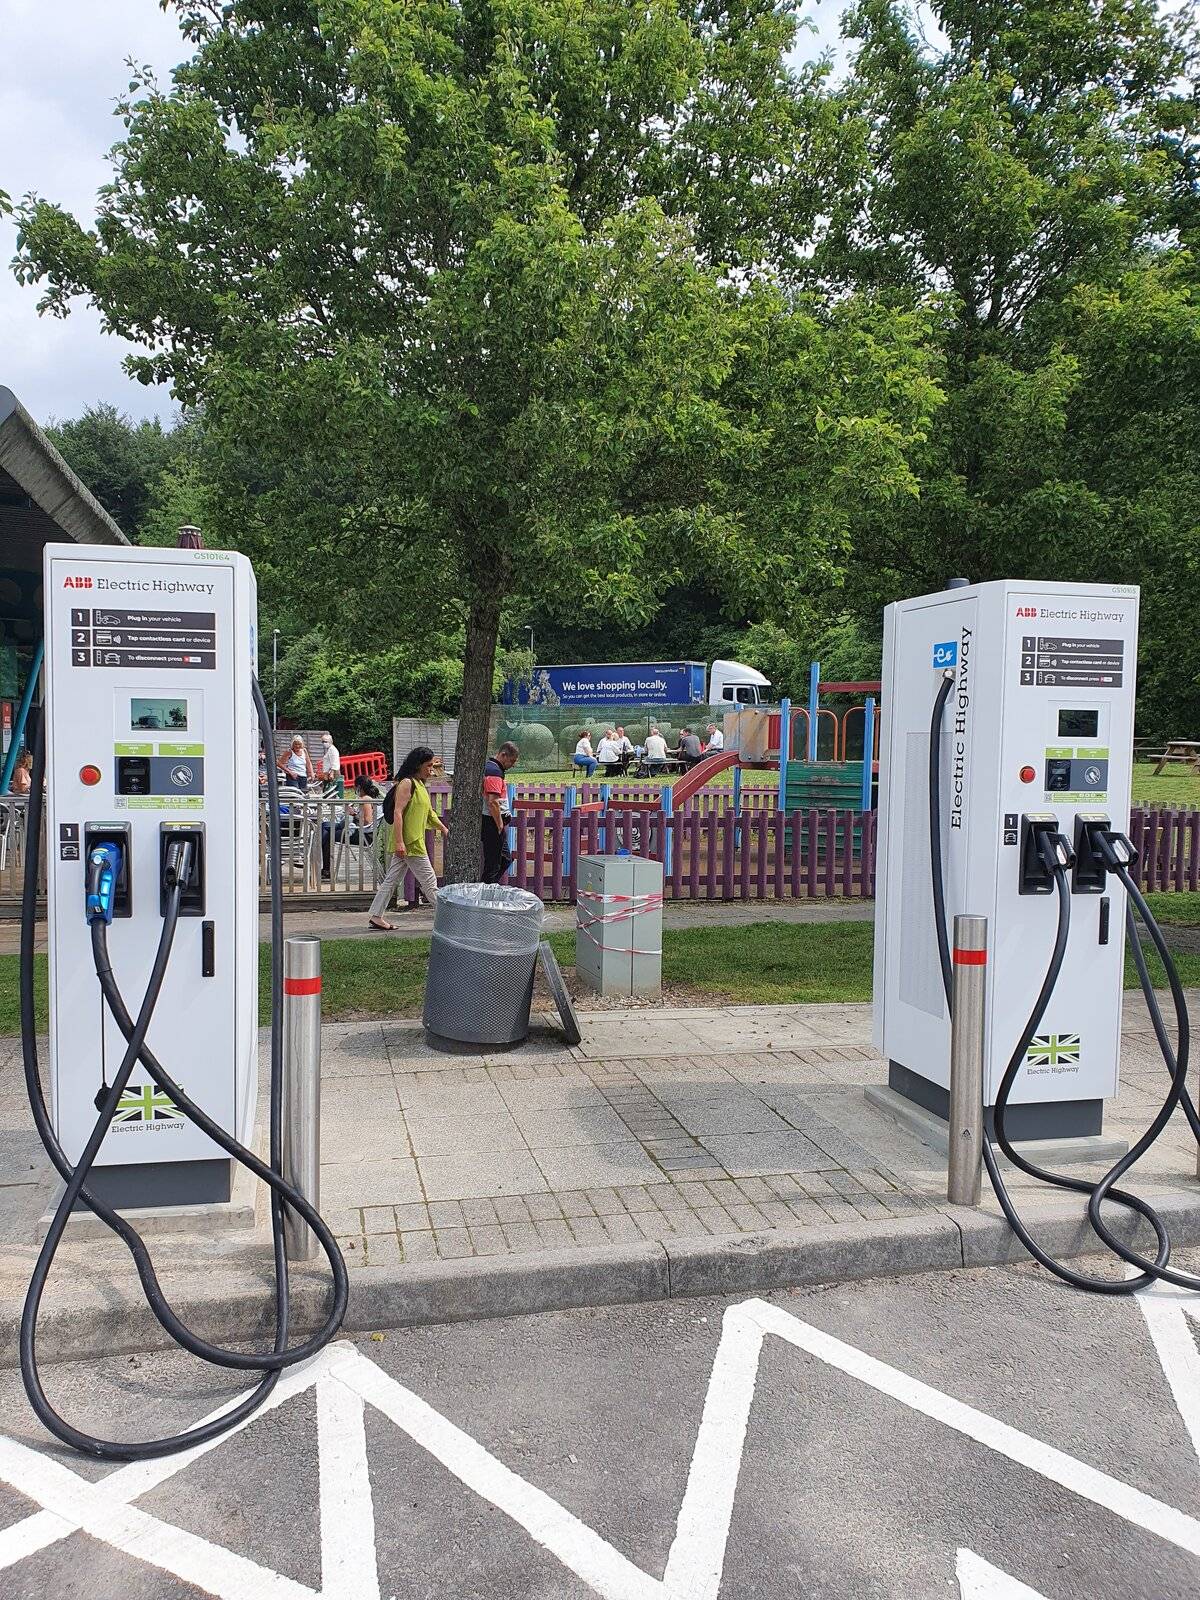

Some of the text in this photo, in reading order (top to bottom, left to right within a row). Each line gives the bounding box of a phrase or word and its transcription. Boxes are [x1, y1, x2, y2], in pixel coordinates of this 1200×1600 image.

[63, 576, 215, 595] ABB Electric Highway
[77, 612, 83, 622] 1
[1016, 607, 1124, 622] ABB Electric Highway
[76, 632, 86, 642] 2
[1026, 639, 1031, 648] 1
[77, 651, 86, 662] 3
[1025, 657, 1032, 665] 2
[1024, 672, 1031, 681] 3
[562, 679, 668, 692] We love shopping locally.
[951, 626, 972, 830] Electric Highway
[1008, 817, 1013, 825] 1
[65, 827, 72, 837] 1
[1051, 1066, 1080, 1074] Highway
[111, 1122, 185, 1133] Electric Highway
